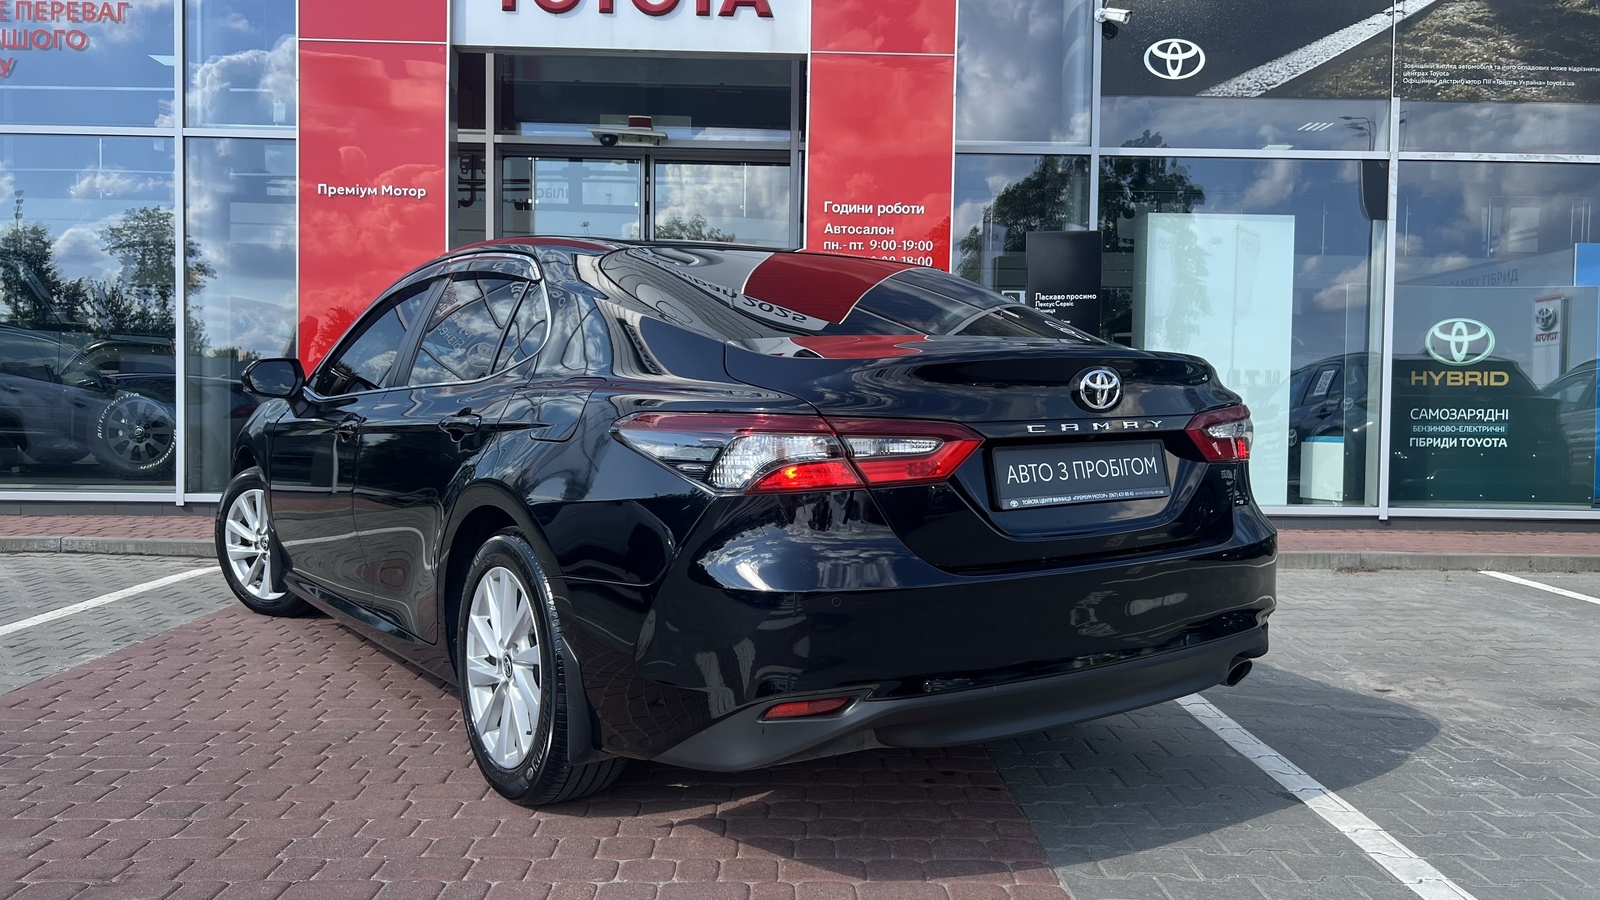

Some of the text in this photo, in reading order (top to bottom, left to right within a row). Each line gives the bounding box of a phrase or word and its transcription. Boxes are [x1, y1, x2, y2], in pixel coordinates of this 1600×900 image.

[15, 1, 130, 21] ПЕРЕВАГ
[0, 29, 87, 50] ШОГО
[317, 184, 427, 199] Преміум Мотор
[823, 201, 925, 217] Години роботи
[824, 223, 895, 235] Автосалон
[1035, 292, 1097, 301] Ласкаво просимо
[1410, 371, 1509, 386] HYBRID
[1410, 408, 1509, 422] САМОЗАРЯДНІ
[1027, 419, 1163, 434] CAMRY
[1412, 425, 1505, 433] БЕНЗИНОВО-ЕЛЕКТРИЧНІ
[1409, 437, 1508, 449] ГІБРИДИ TOYOTA
[1007, 463, 1054, 485] АВТО
[1072, 456, 1159, 480] ПРОБІГОМ
